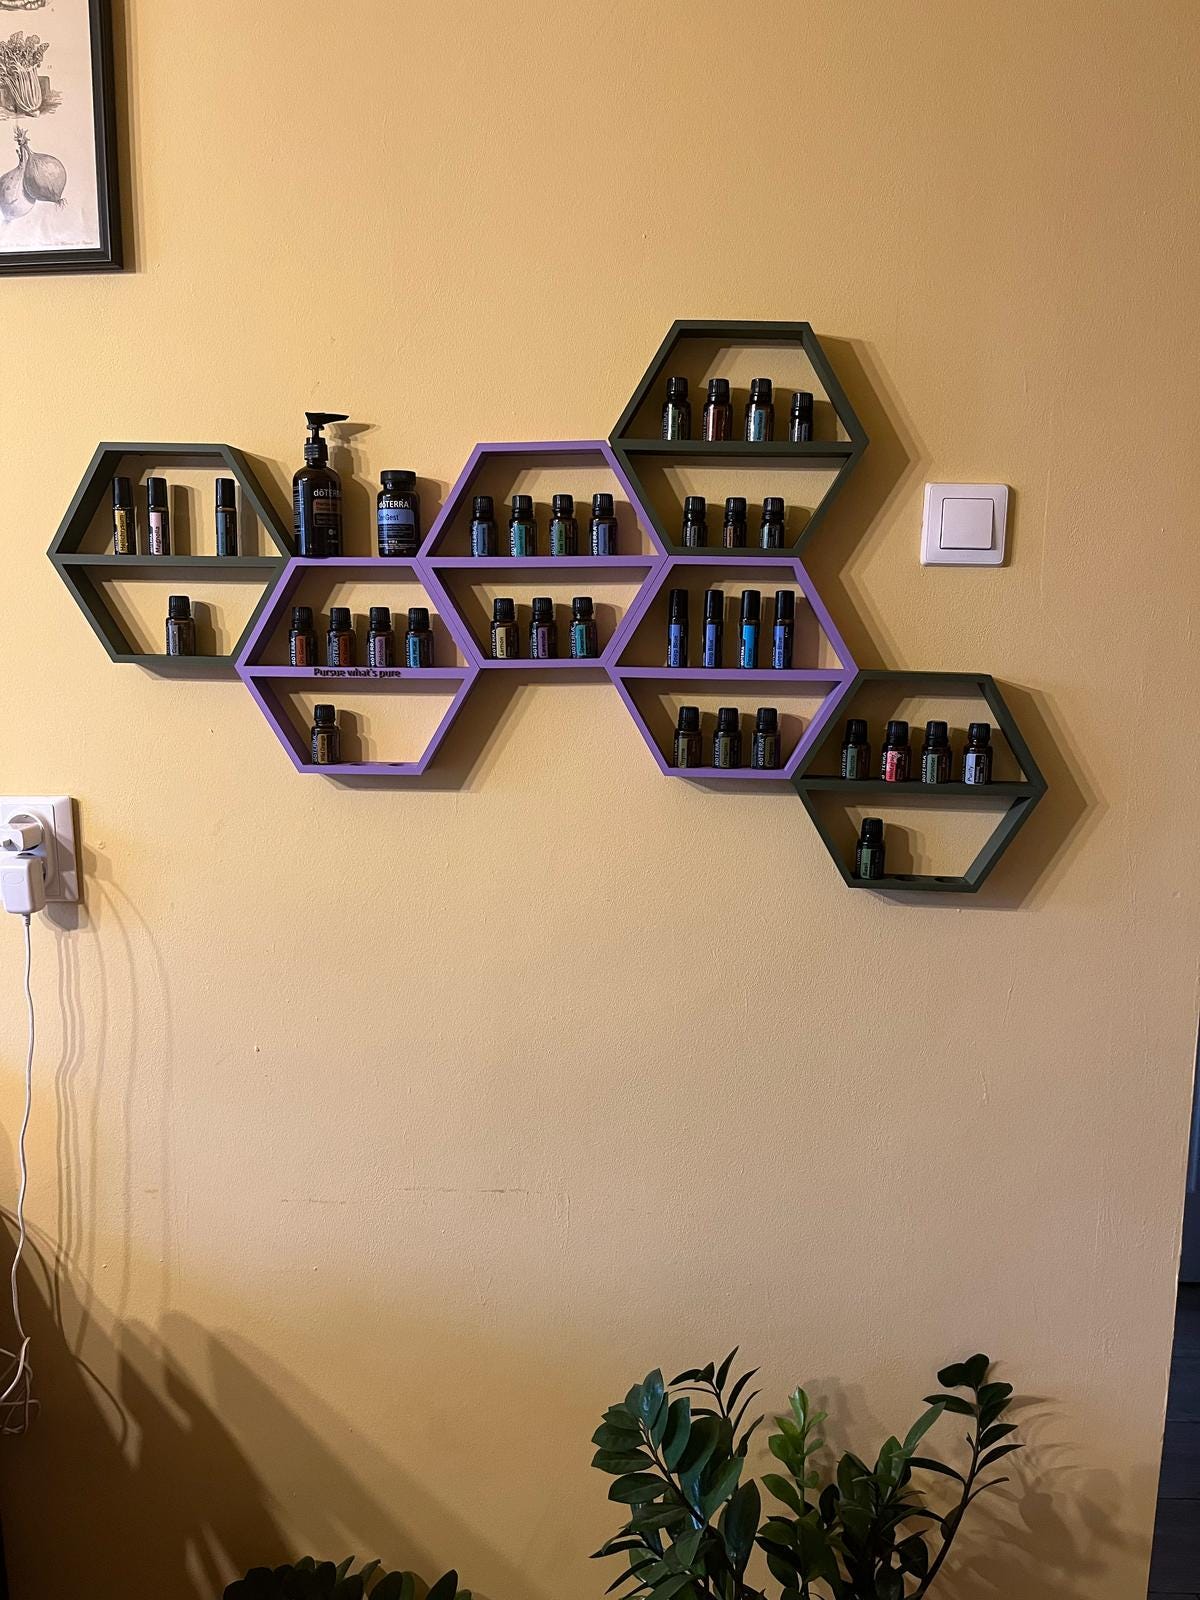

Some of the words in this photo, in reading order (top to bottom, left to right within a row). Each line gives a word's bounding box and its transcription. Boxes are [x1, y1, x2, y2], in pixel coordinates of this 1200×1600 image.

[314, 668, 346, 677] Pursue
[347, 668, 378, 677] what's
[379, 670, 401, 678] pure
